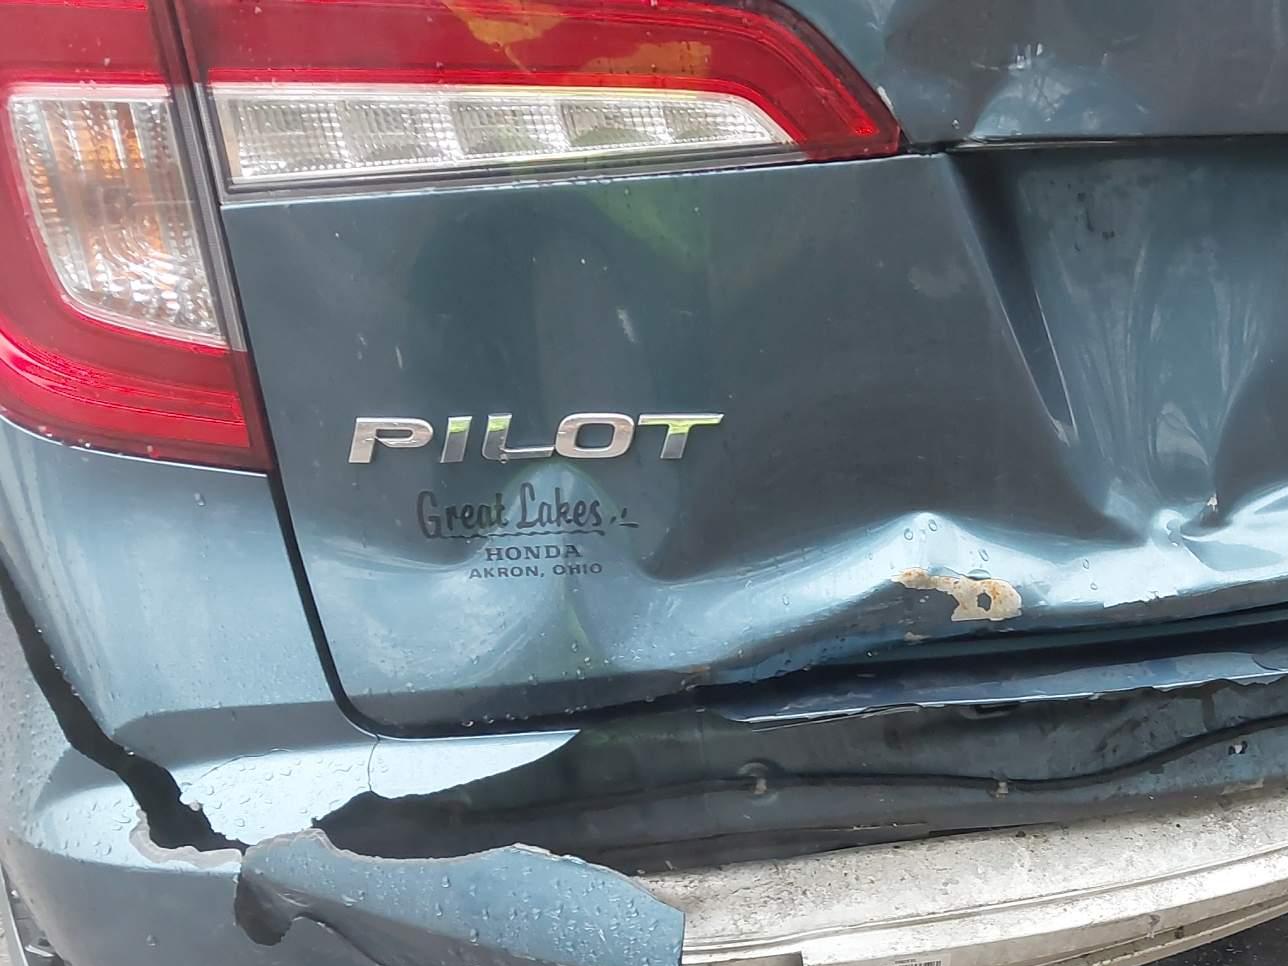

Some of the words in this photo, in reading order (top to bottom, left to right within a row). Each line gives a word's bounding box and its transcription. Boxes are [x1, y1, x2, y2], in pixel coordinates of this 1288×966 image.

[348, 412, 725, 465] PILOT
[417, 490, 509, 539] Great
[516, 482, 604, 530] Lakes
[485, 544, 584, 562] HONDA
[468, 564, 546, 580] AKRON,
[552, 562, 603, 577] OHIO
